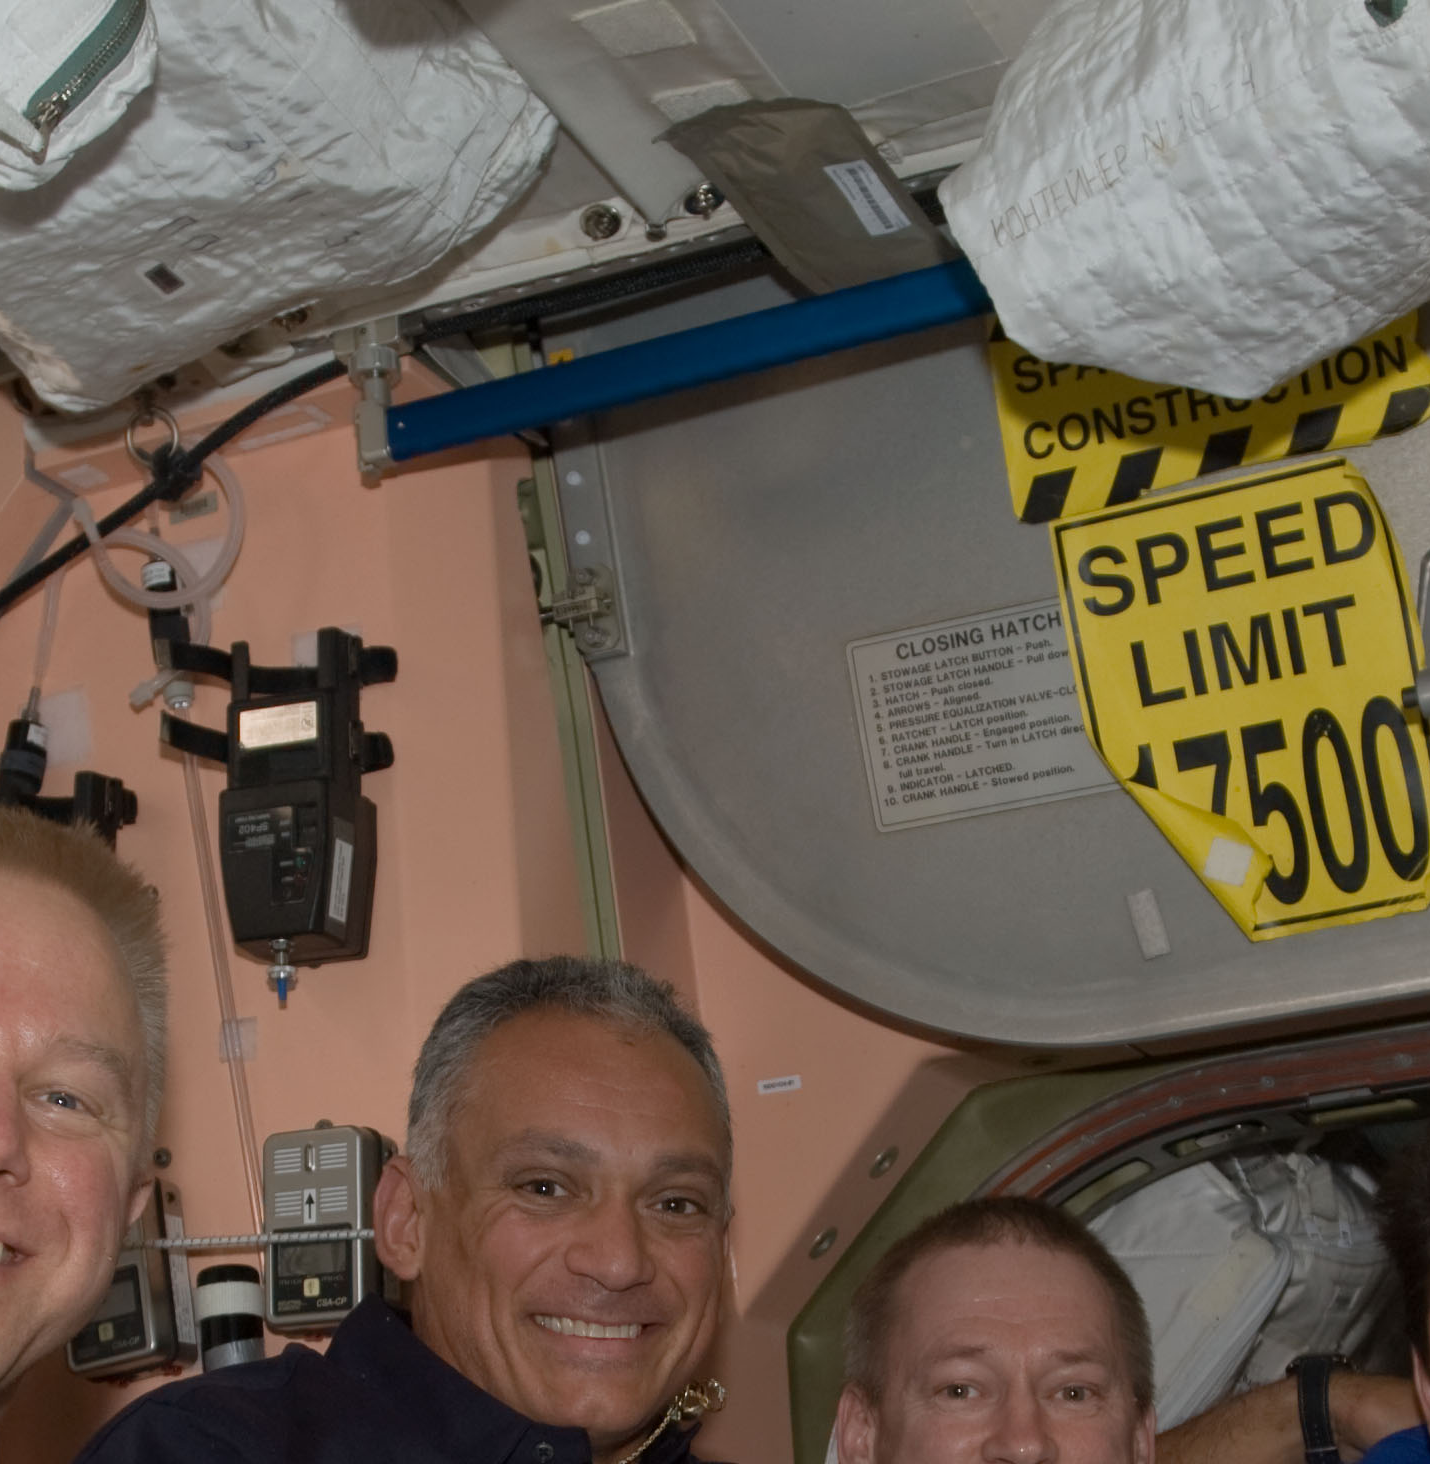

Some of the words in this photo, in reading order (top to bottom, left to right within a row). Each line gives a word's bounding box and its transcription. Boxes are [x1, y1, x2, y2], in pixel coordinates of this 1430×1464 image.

[1077, 491, 1376, 616] SPEED
[896, 626, 985, 661] CLOSING
[991, 610, 1063, 641] HATCH
[1130, 594, 1356, 707] LIMIT
[880, 661, 932, 682] STOWAGE
[934, 655, 969, 670] LATCH
[972, 645, 1014, 664] BUTTON
[1024, 637, 1054, 652] Push.
[882, 676, 934, 695] STOWAGE
[936, 668, 971, 683] LATCH
[973, 659, 1015, 676] HANDLE
[1026, 651, 1045, 665] Pull
[1047, 648, 1070, 661] dow
[884, 691, 920, 707] HATCH
[930, 684, 955, 698] Push
[957, 677, 994, 692] closed.
[887, 701, 931, 718] ARROWS
[942, 691, 983, 707] Aligned.
[889, 712, 941, 730] PRESSURE
[943, 698, 1017, 720] EQUALIZATION
[891, 726, 937, 743] RATCHET
[949, 718, 984, 733] LATCH
[986, 710, 1030, 726] position.
[893, 740, 928, 755] CRANK
[931, 732, 971, 749] HANDLE
[983, 723, 1026, 739] Engaged
[1028, 713, 1073, 730] position.
[895, 753, 930, 768] CRANK
[933, 745, 973, 761] HANDLE
[985, 739, 1008, 752] Turn
[1022, 728, 1057, 744] LATCH
[1060, 723, 1086, 736] direc
[898, 767, 919, 781] full
[900, 773, 954, 792] INDICATOR
[965, 761, 1016, 779] LATCHED.
[902, 789, 937, 804] CRANK
[939, 781, 980, 797] HANDLE
[991, 773, 1029, 788] Stowed
[1032, 763, 1076, 780] position.
[1125, 695, 1430, 905] 7500
